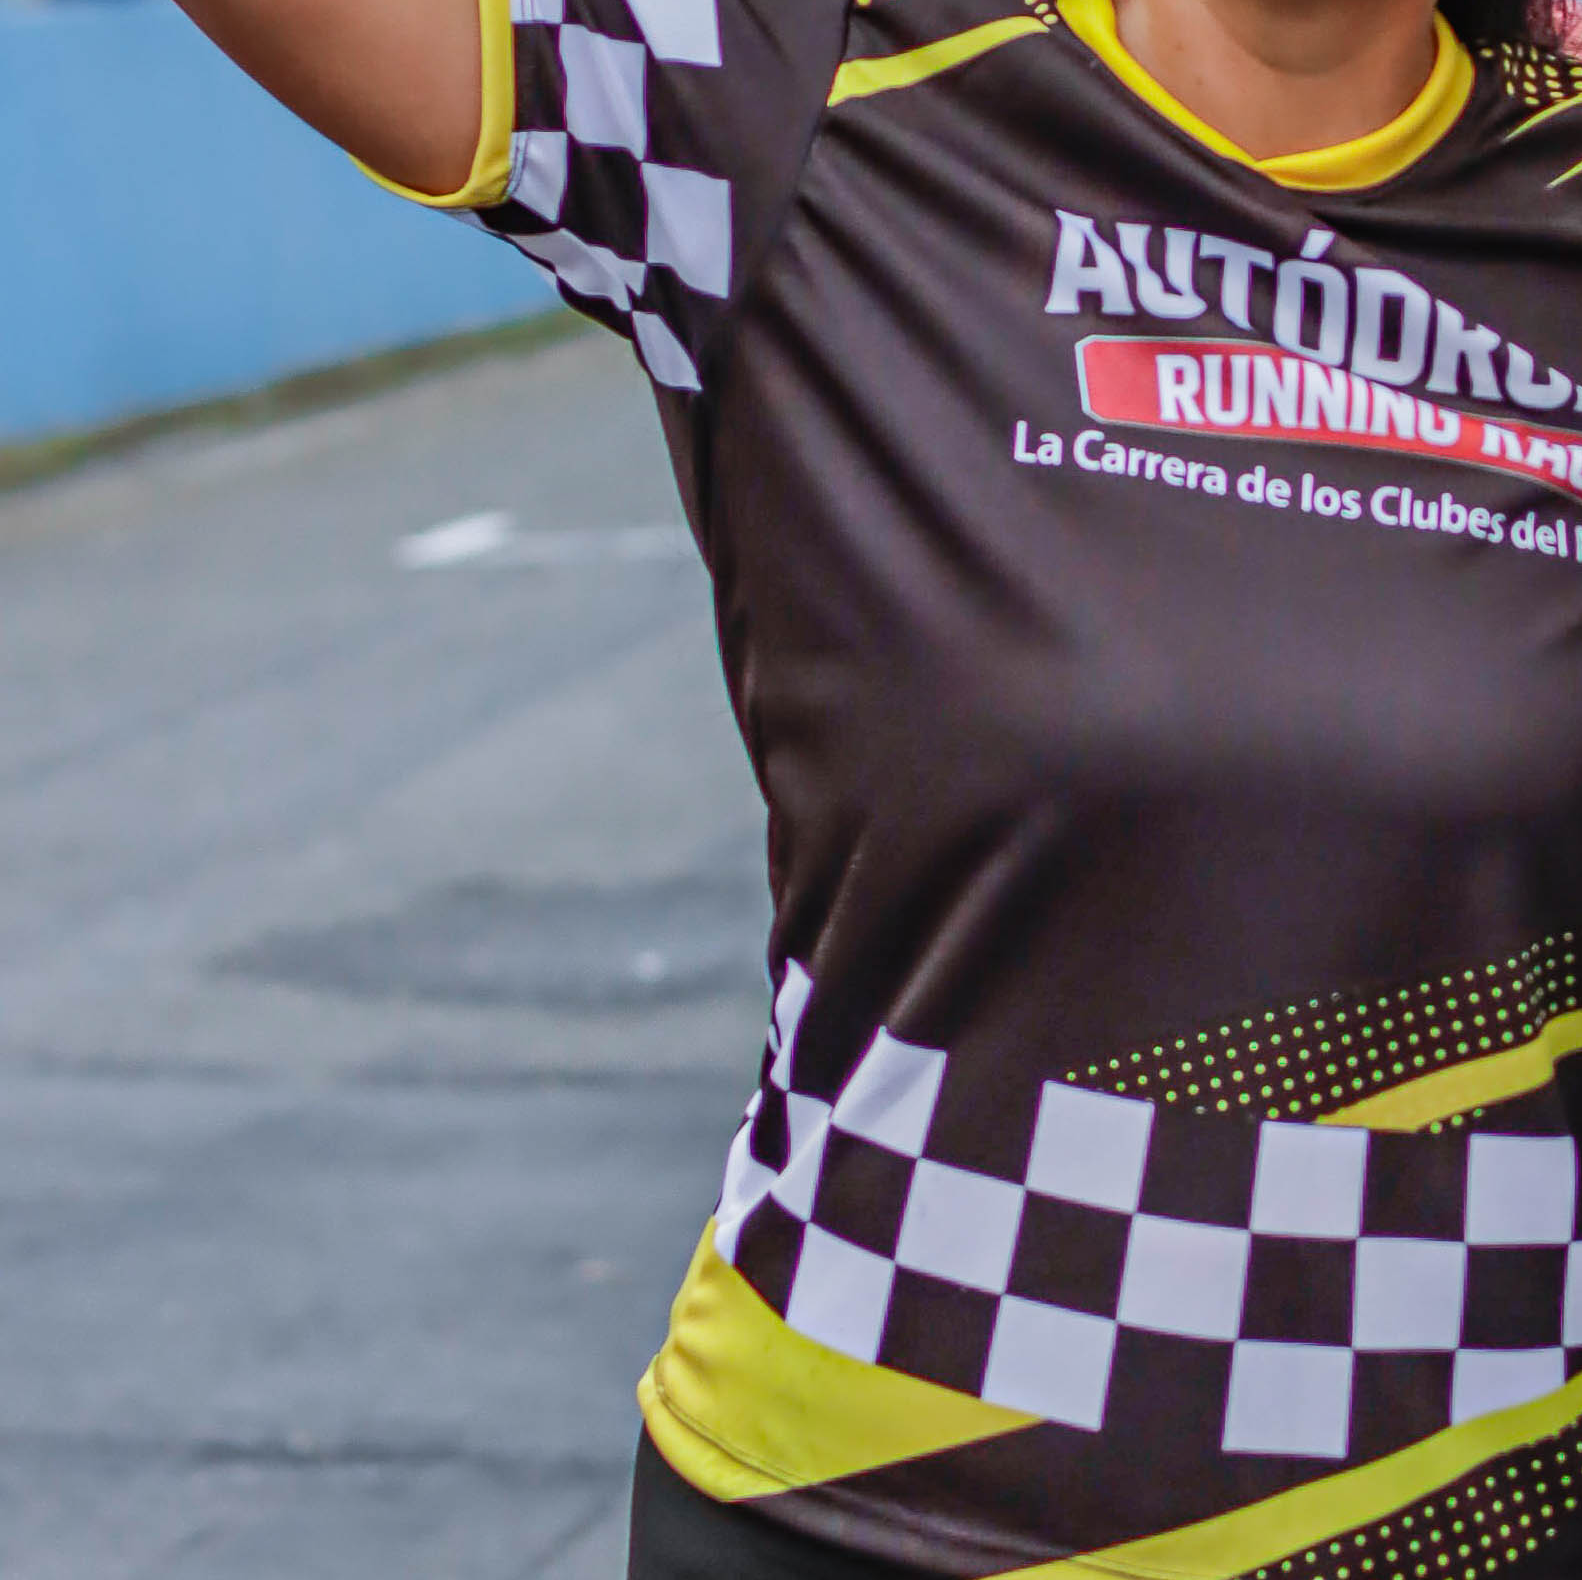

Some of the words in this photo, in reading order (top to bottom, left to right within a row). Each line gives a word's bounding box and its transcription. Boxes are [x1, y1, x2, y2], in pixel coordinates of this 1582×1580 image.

[1014, 420, 1063, 465] La
[1073, 430, 1227, 496] Carrera
[1237, 465, 1292, 508] de
[1300, 473, 1362, 520] los
[1370, 484, 1506, 544] Clubes
[1511, 511, 1568, 558] del
